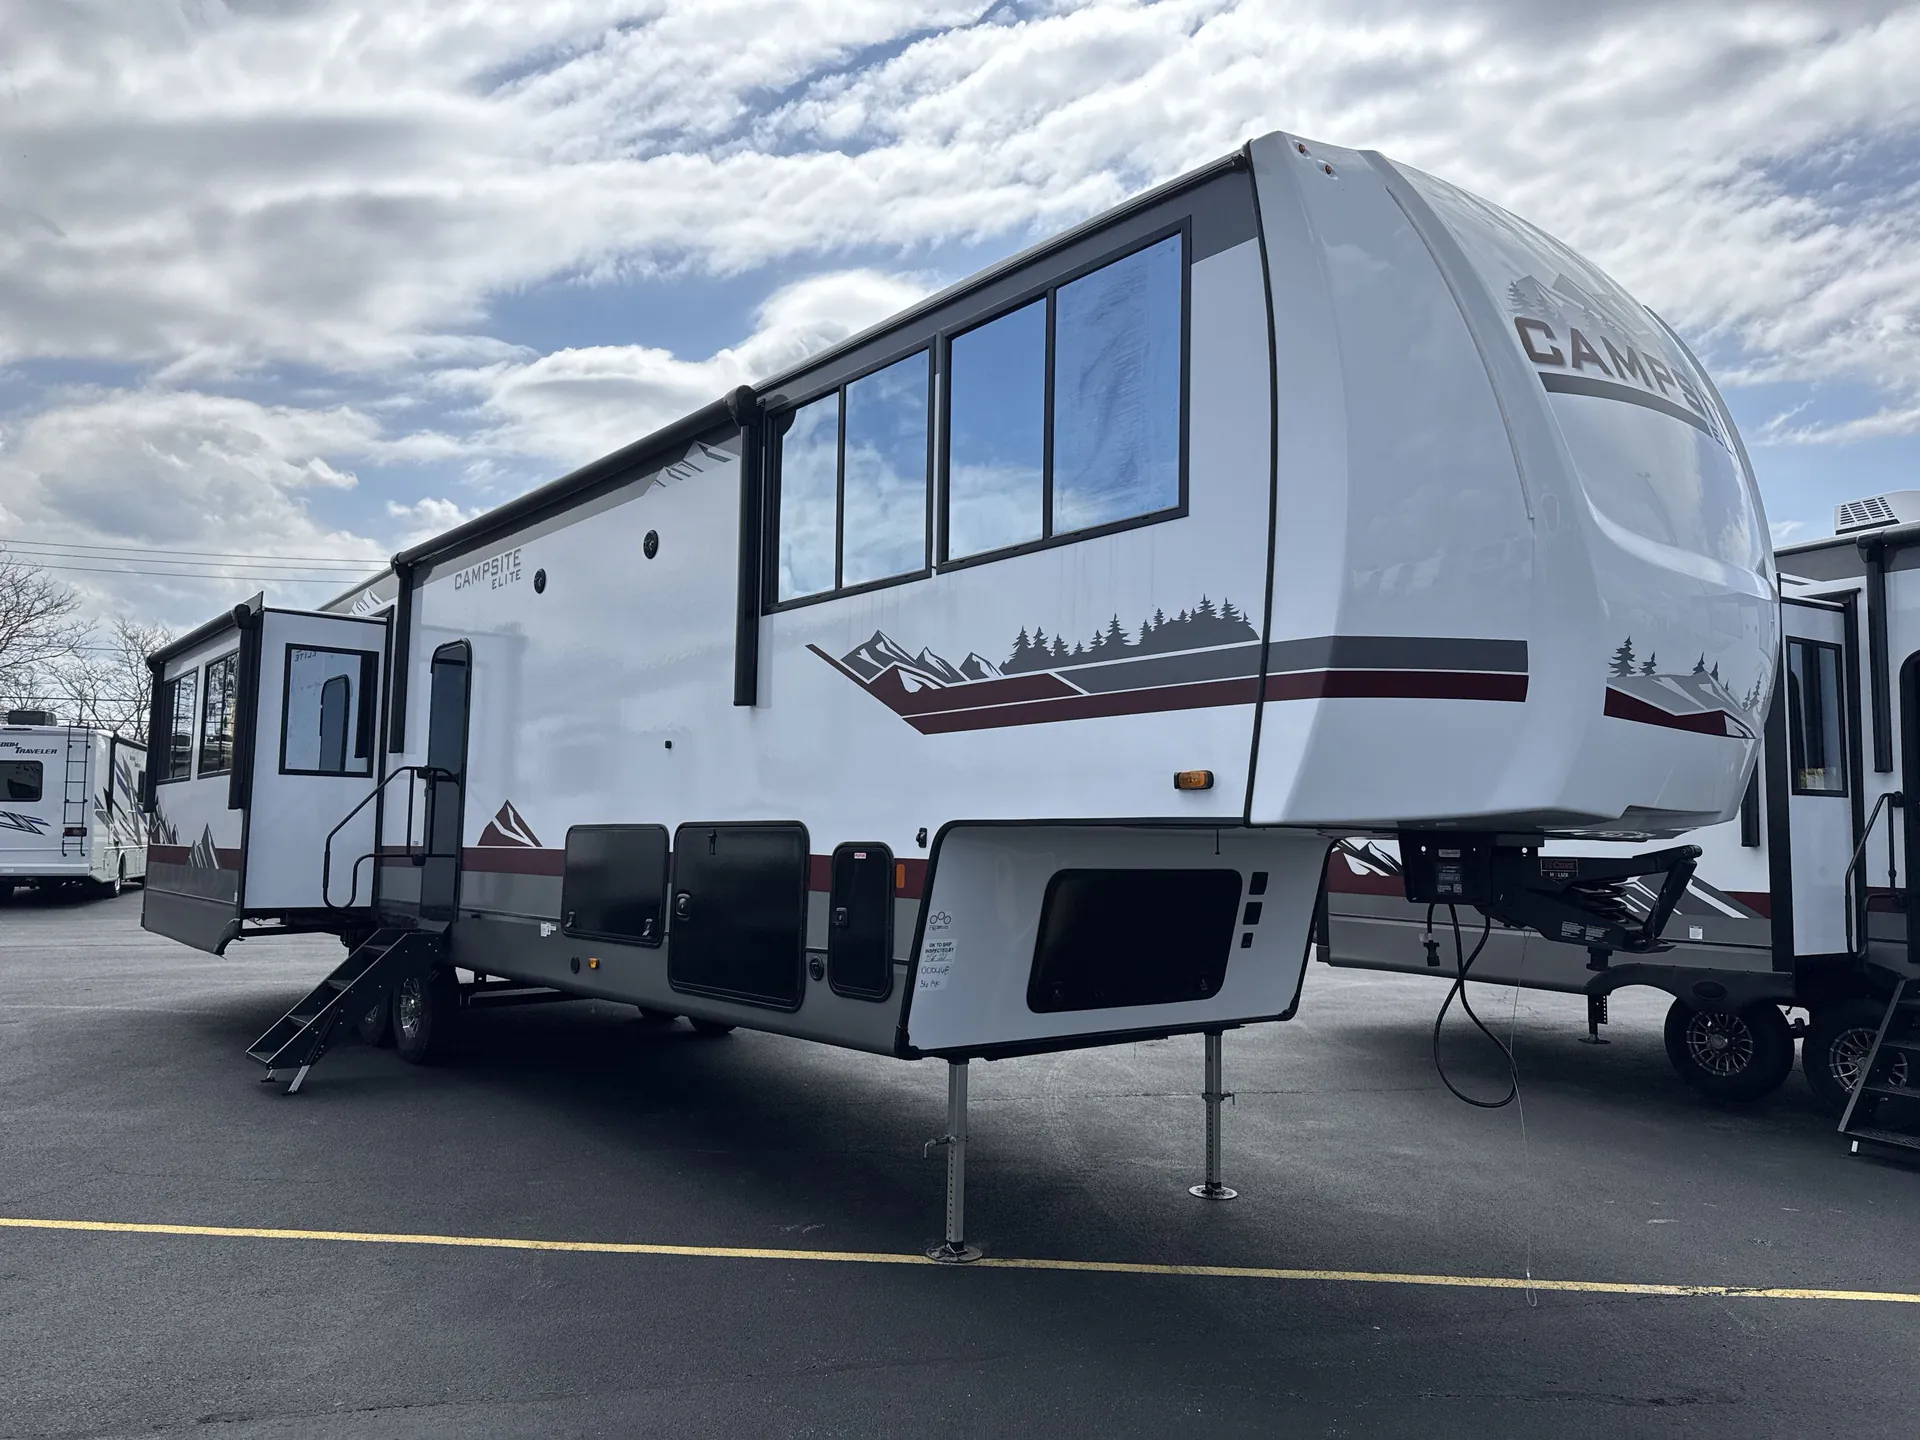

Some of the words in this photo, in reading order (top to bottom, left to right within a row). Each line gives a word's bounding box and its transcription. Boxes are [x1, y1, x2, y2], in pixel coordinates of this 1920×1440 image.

[1514, 316, 1729, 437] CAMPSIT
[455, 548, 521, 590] CAMPSITE
[491, 568, 522, 590] ELITE
